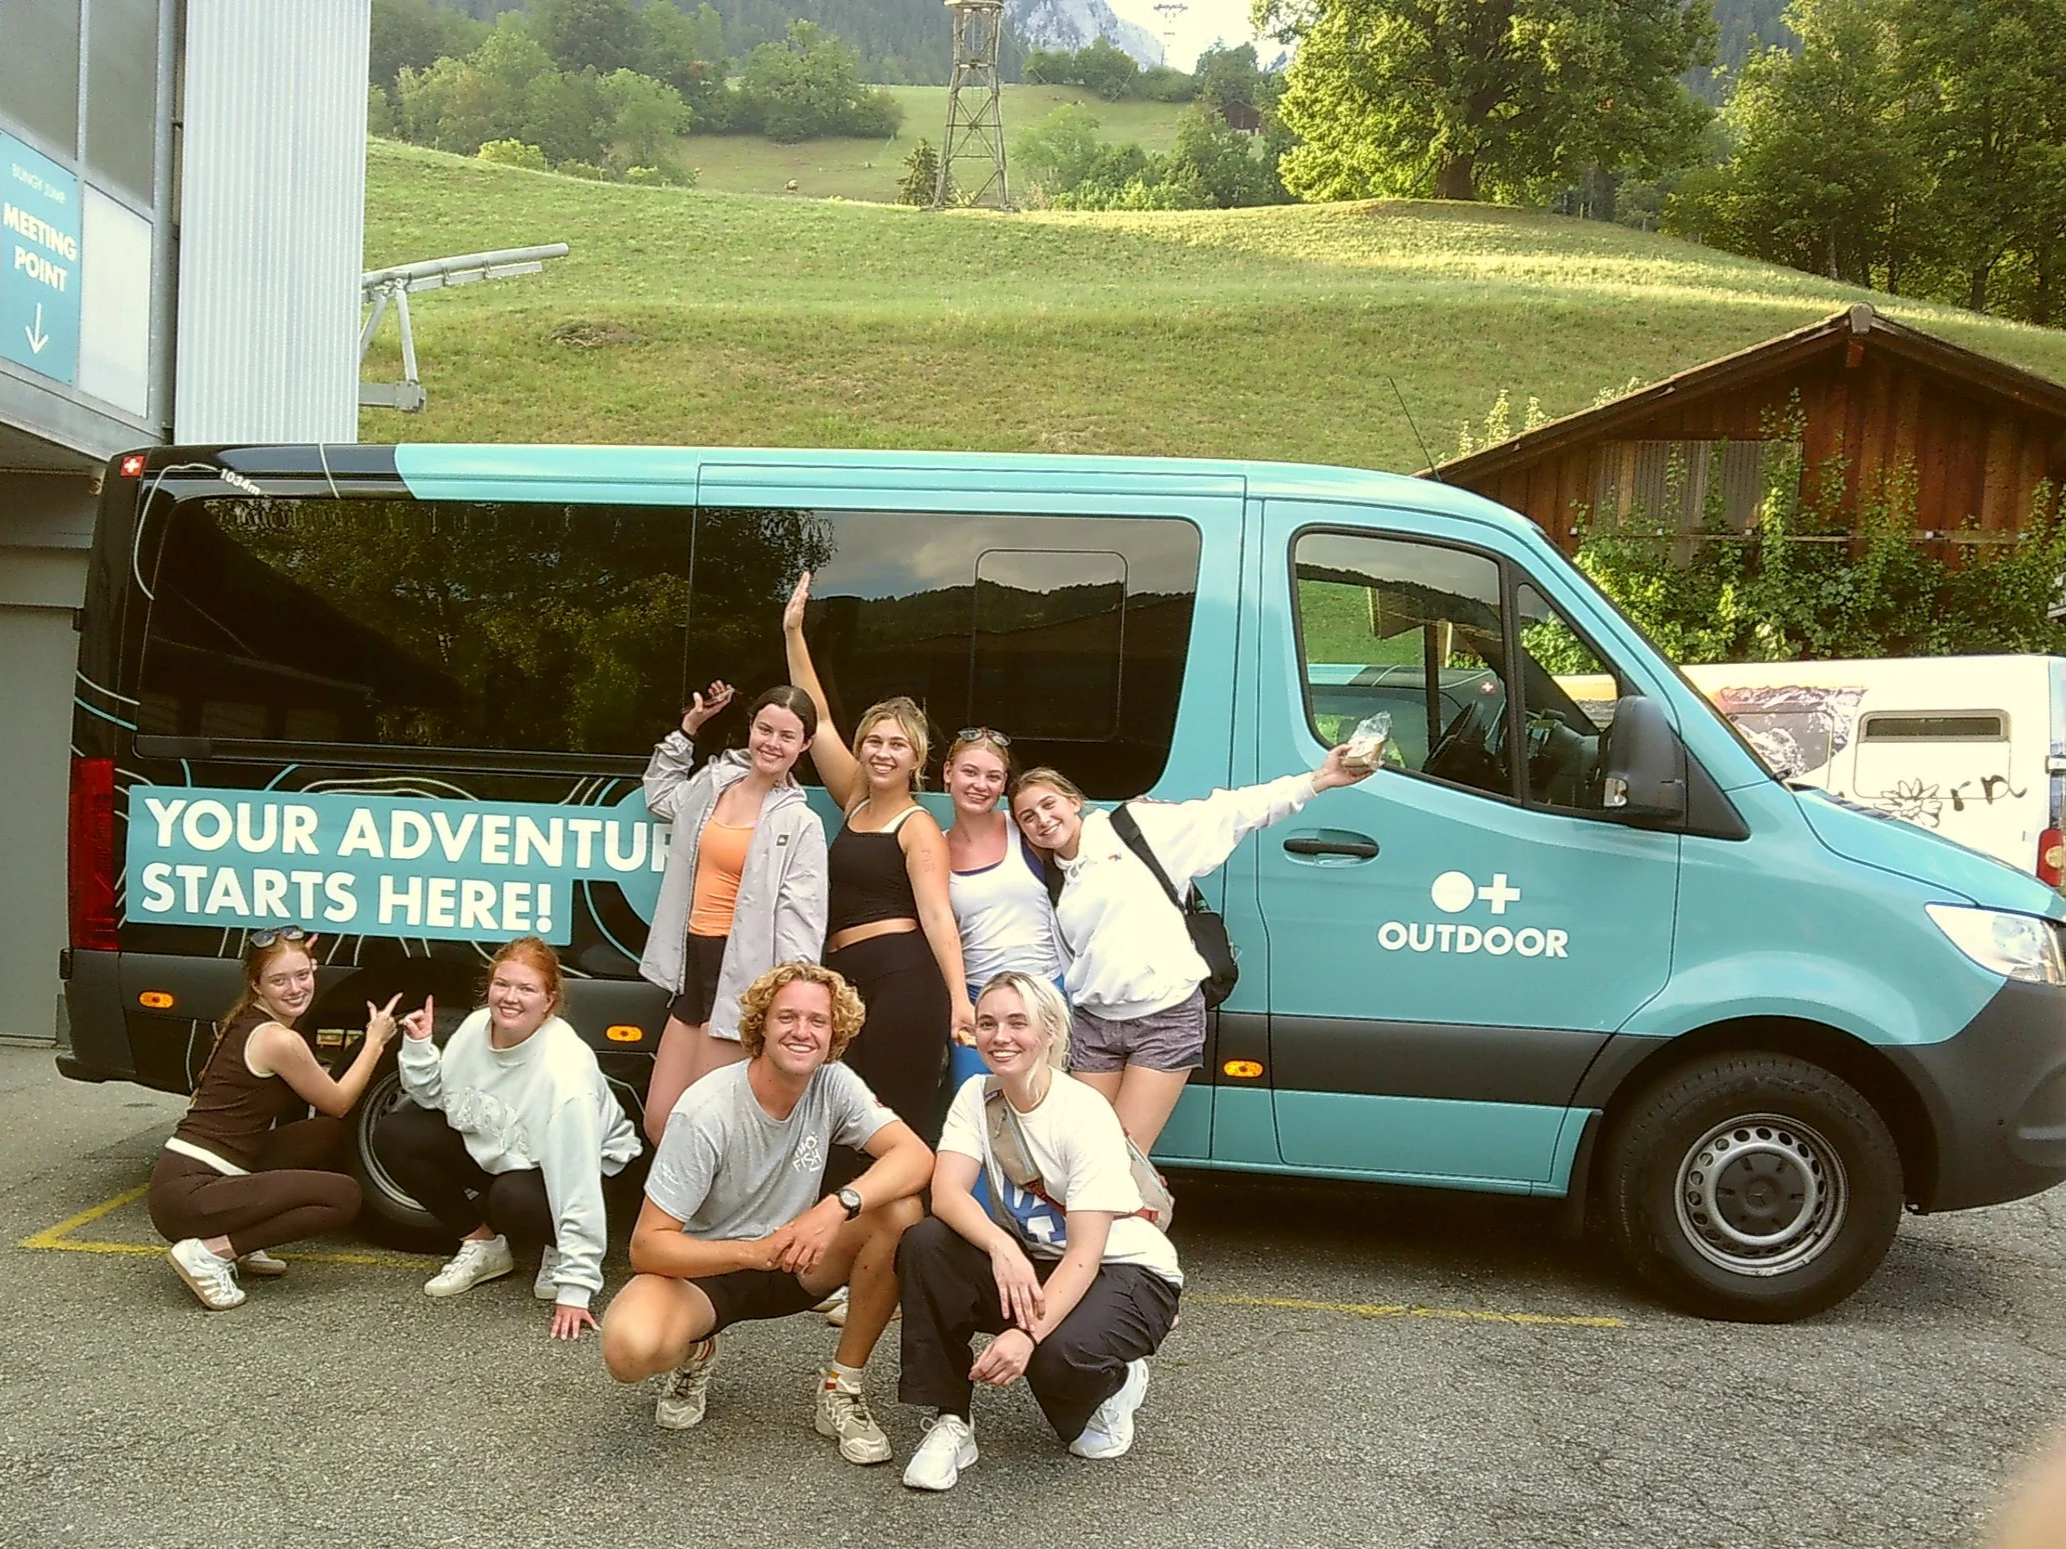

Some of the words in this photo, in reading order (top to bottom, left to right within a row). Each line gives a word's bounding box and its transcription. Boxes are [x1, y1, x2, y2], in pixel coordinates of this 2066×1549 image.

[3, 202, 78, 261] MEETING
[14, 246, 67, 292] POINT
[220, 468, 261, 496] 1034m
[144, 797, 320, 855] YOUR
[337, 808, 672, 872] ADVENTUR
[141, 862, 358, 923] STARTS
[378, 874, 553, 934] HERE!
[1377, 921, 1569, 958] OUTDOOR
[792, 1148, 823, 1173] FISH
